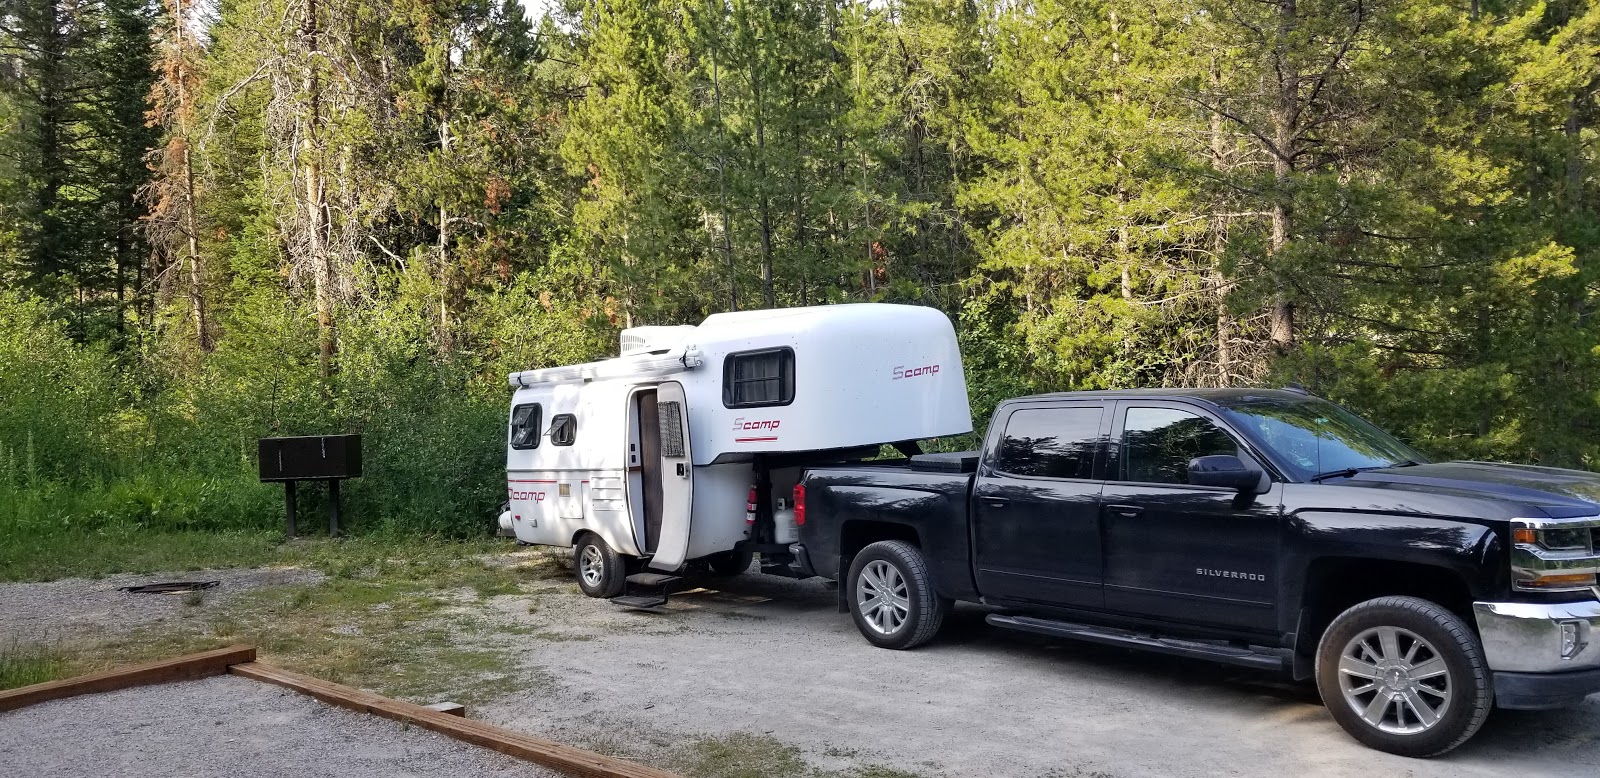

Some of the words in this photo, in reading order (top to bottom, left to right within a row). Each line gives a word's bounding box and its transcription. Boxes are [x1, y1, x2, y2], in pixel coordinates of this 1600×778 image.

[892, 364, 940, 381] Scamp
[732, 416, 781, 432] Scamp
[1196, 568, 1265, 581] SILVERADO
